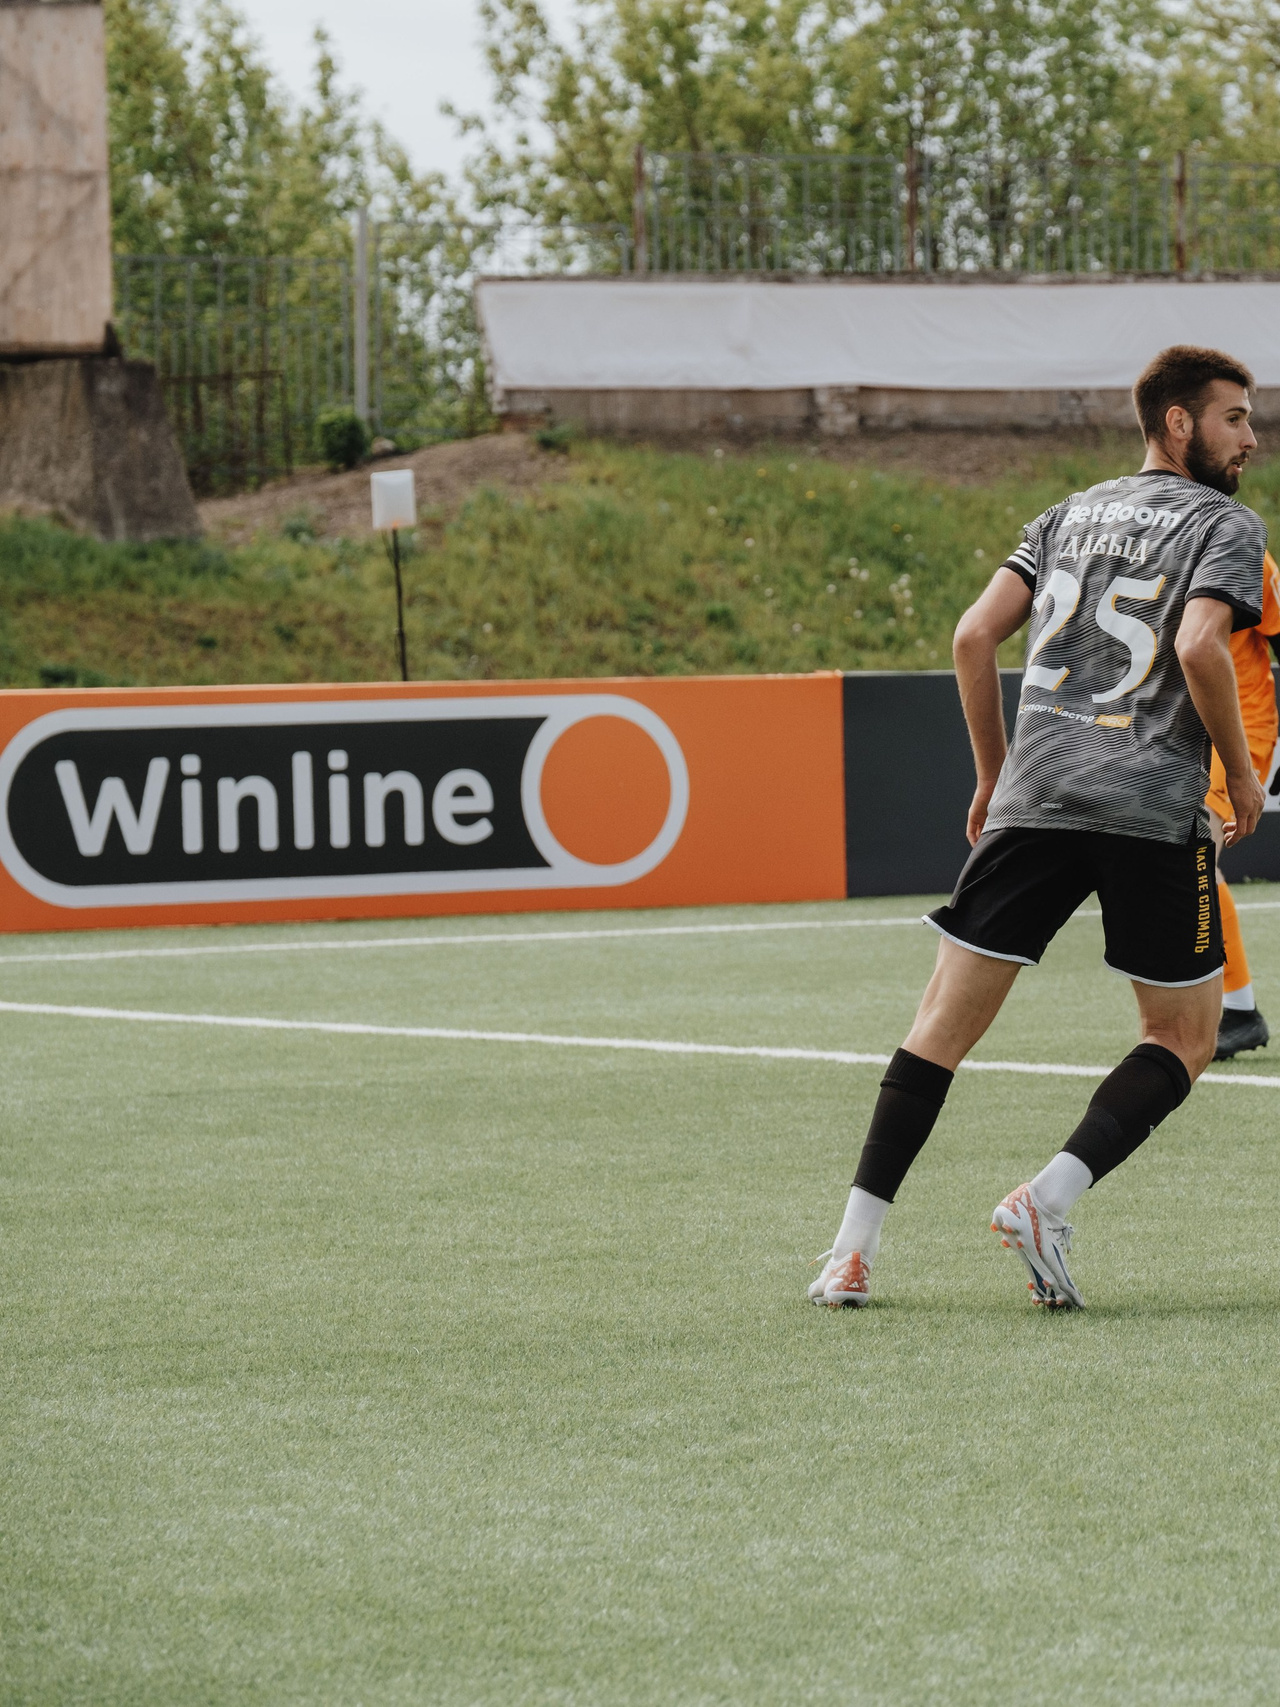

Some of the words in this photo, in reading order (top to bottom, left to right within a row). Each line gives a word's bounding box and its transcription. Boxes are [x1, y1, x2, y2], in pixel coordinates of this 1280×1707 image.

[1061, 502, 1181, 528] BetBoom
[1021, 569, 1167, 703] 25
[1099, 716, 1129, 727] PRO
[54, 749, 494, 858] Winline
[1198, 875, 1209, 892] НЕ
[1194, 894, 1210, 954] СЛОМАТЬ
